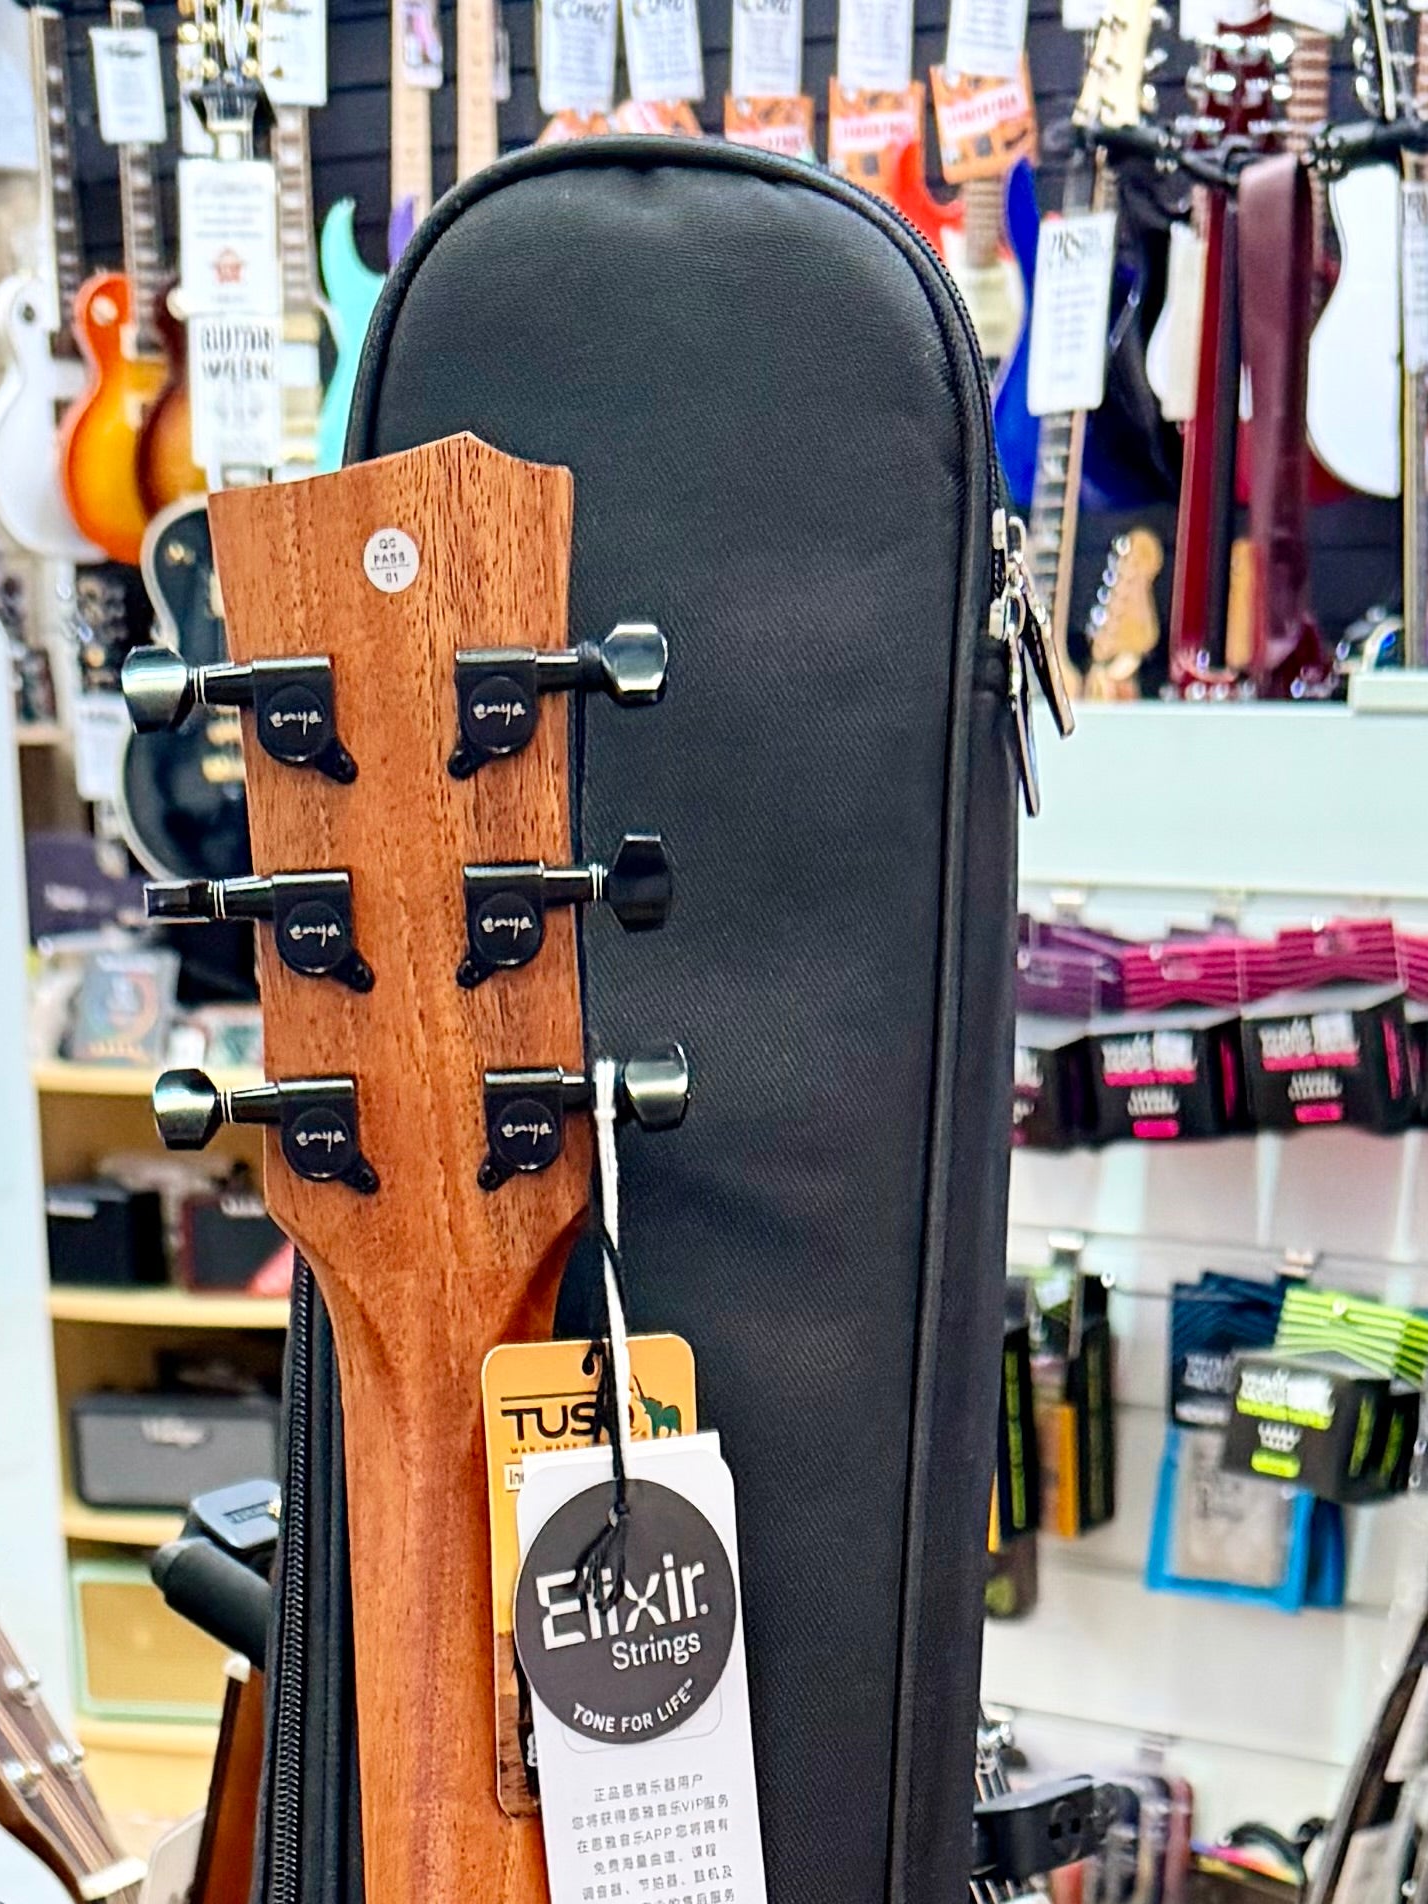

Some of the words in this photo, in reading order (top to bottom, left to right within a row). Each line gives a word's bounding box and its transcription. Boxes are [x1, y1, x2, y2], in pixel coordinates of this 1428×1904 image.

[373, 553, 406, 564] PASS
[612, 1632, 701, 1671] Strings
[573, 1702, 616, 1733] TONE
[621, 1712, 653, 1733] FOR
[657, 1687, 692, 1722] LIFE
